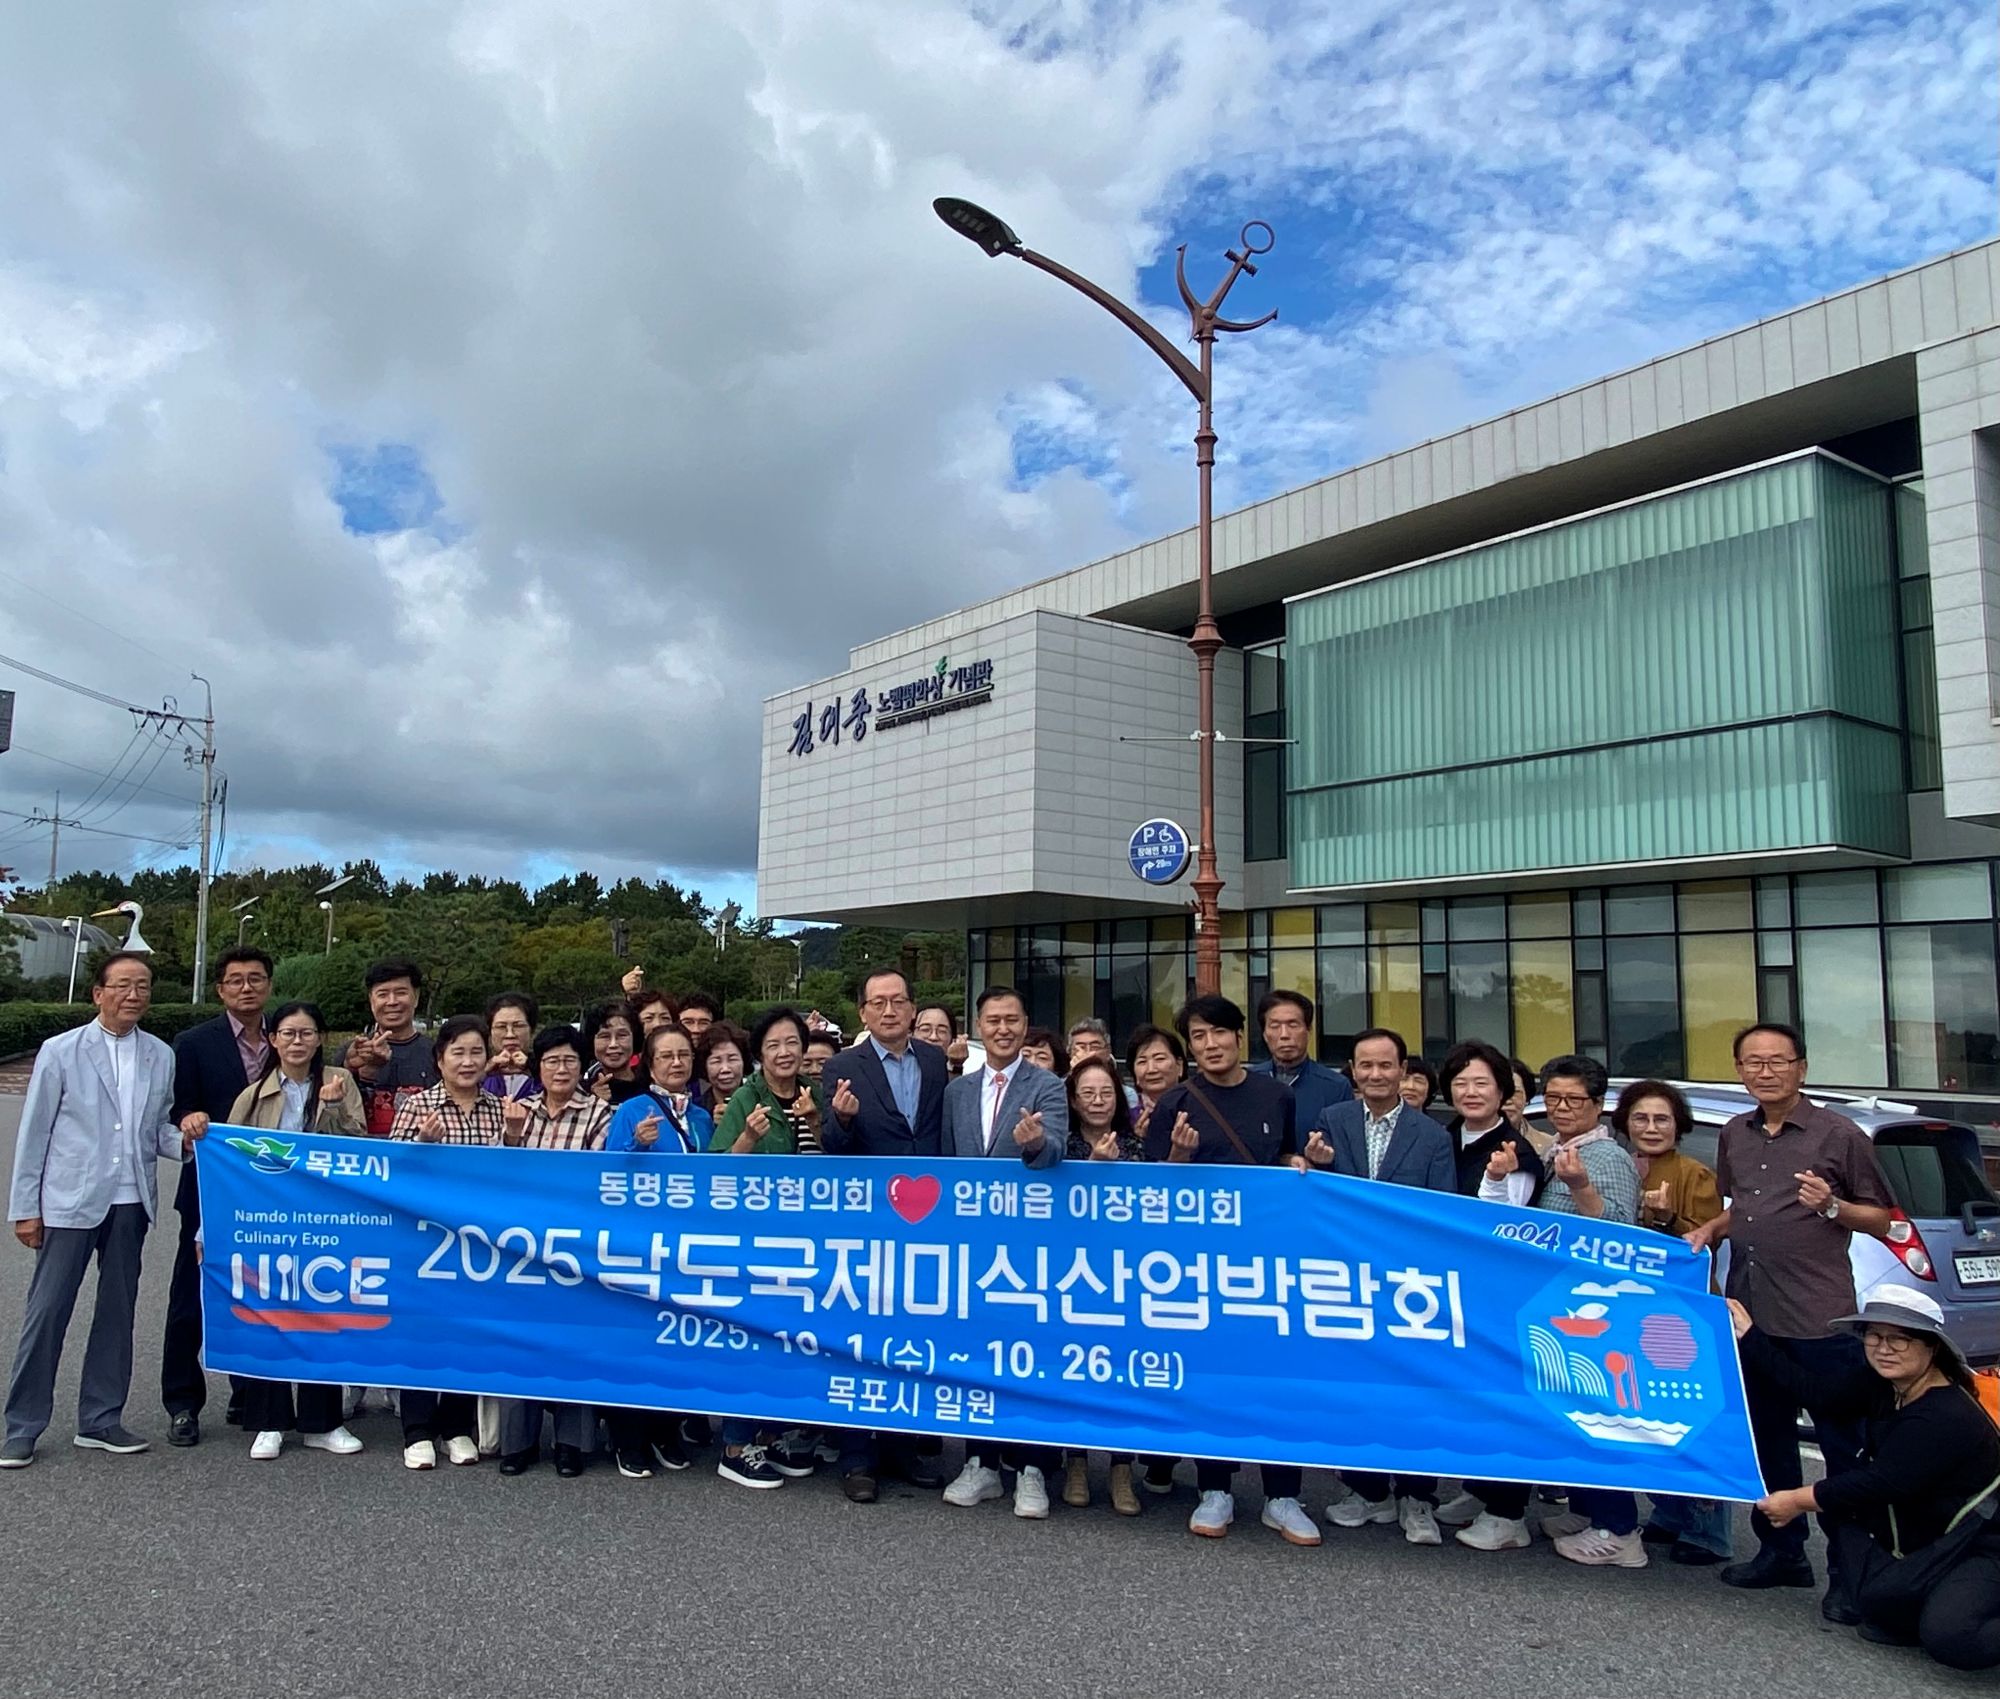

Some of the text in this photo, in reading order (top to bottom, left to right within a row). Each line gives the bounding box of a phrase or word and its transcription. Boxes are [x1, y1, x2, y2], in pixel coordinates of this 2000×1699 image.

[948, 659, 994, 692] 기념관
[1143, 827, 1155, 843] P
[305, 1150, 390, 1181] 목포시
[599, 1171, 1242, 1226] 동명동 통장협의회 압해읍 이장협의회
[234, 1210, 393, 1226] Namdo International
[234, 1230, 339, 1248] Culinary Expo
[1569, 1235, 1668, 1276] 신안군
[231, 1252, 391, 1306] NICE
[656, 1311, 760, 1351] 2025.
[987, 1341, 1045, 1379] 10.
[1061, 1343, 1185, 1391] 26.(일)
[827, 1375, 996, 1425] 목포시 일원
